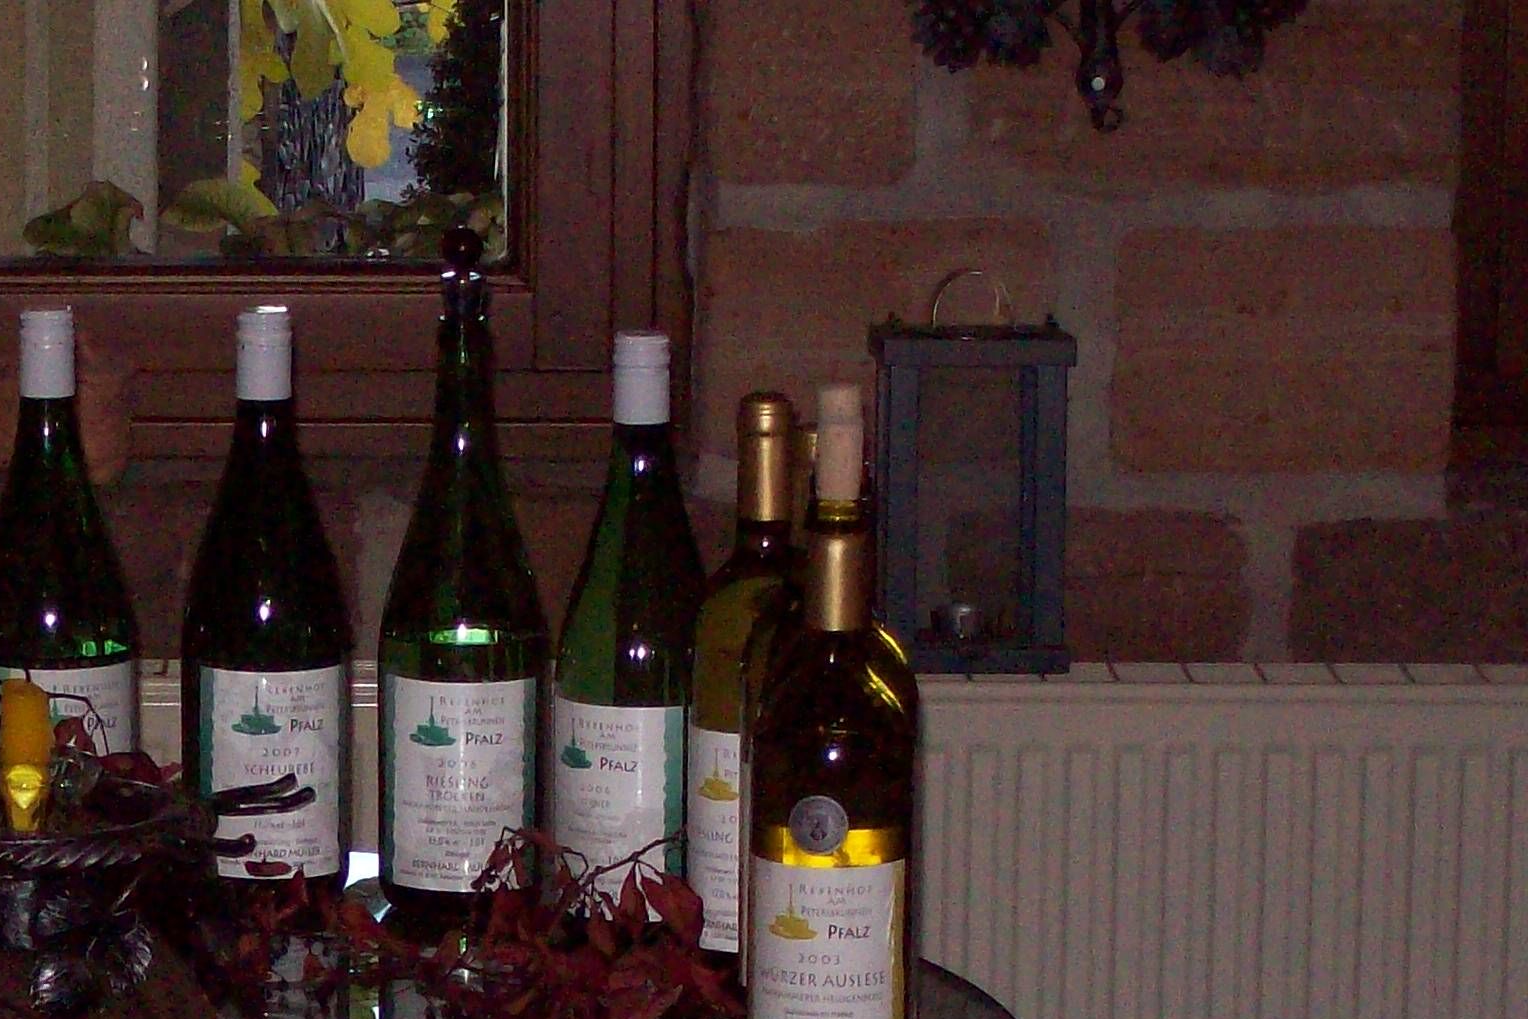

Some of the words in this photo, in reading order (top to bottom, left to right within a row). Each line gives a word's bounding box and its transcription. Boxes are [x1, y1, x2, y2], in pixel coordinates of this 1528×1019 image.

[289, 718, 324, 732] PFALZ
[465, 732, 504, 745] PFALZ
[599, 757, 638, 772] PFALZ
[827, 924, 872, 940] PFALZ
[797, 952, 841, 965] 2003
[822, 970, 886, 988] AUSLESE
